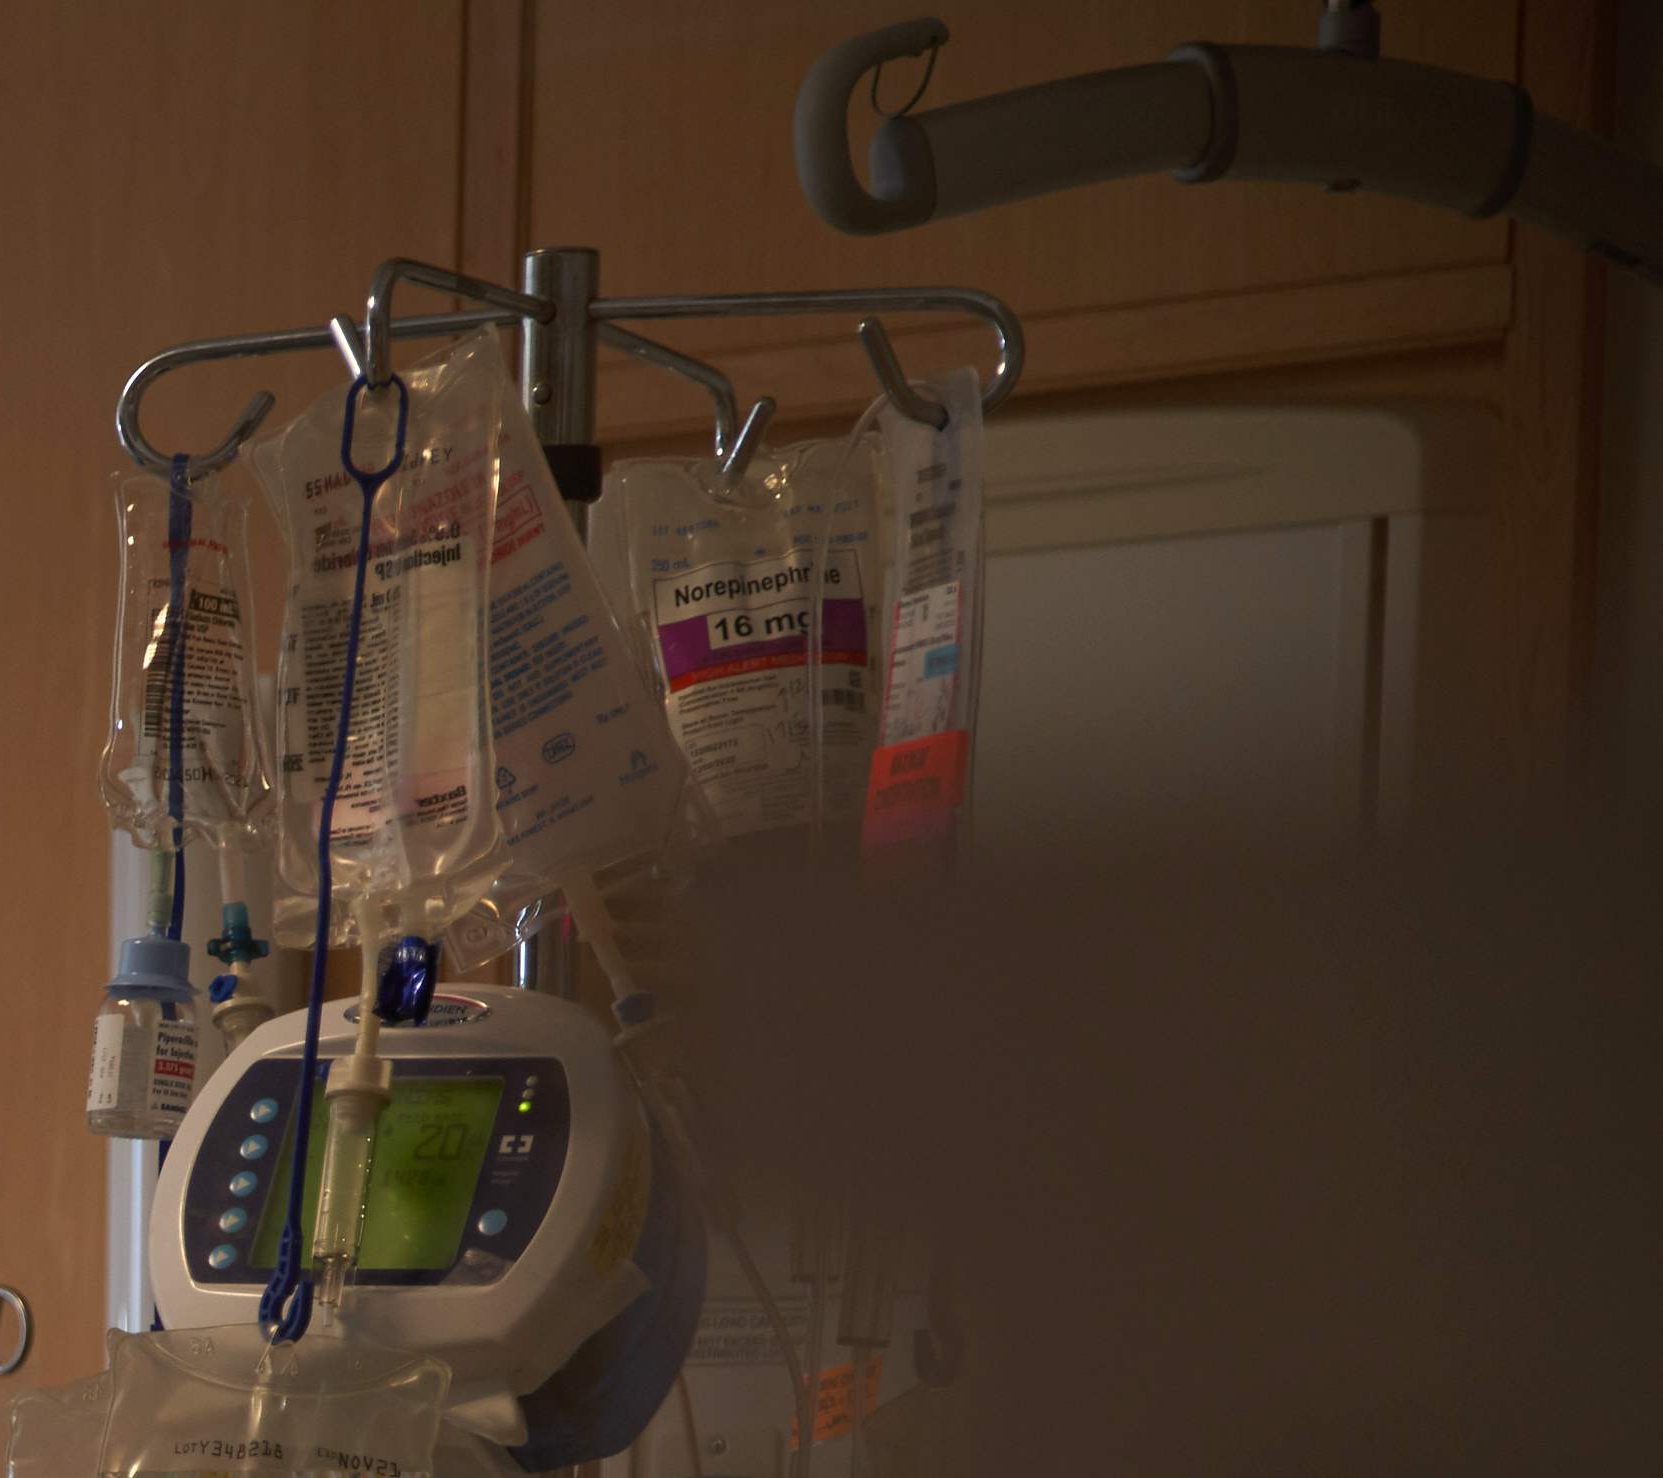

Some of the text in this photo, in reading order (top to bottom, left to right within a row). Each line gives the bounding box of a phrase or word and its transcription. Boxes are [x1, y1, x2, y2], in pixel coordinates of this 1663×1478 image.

[674, 561, 841, 608] Norepinephrne
[714, 614, 753, 642] 16
[414, 1123, 469, 1161] 20
